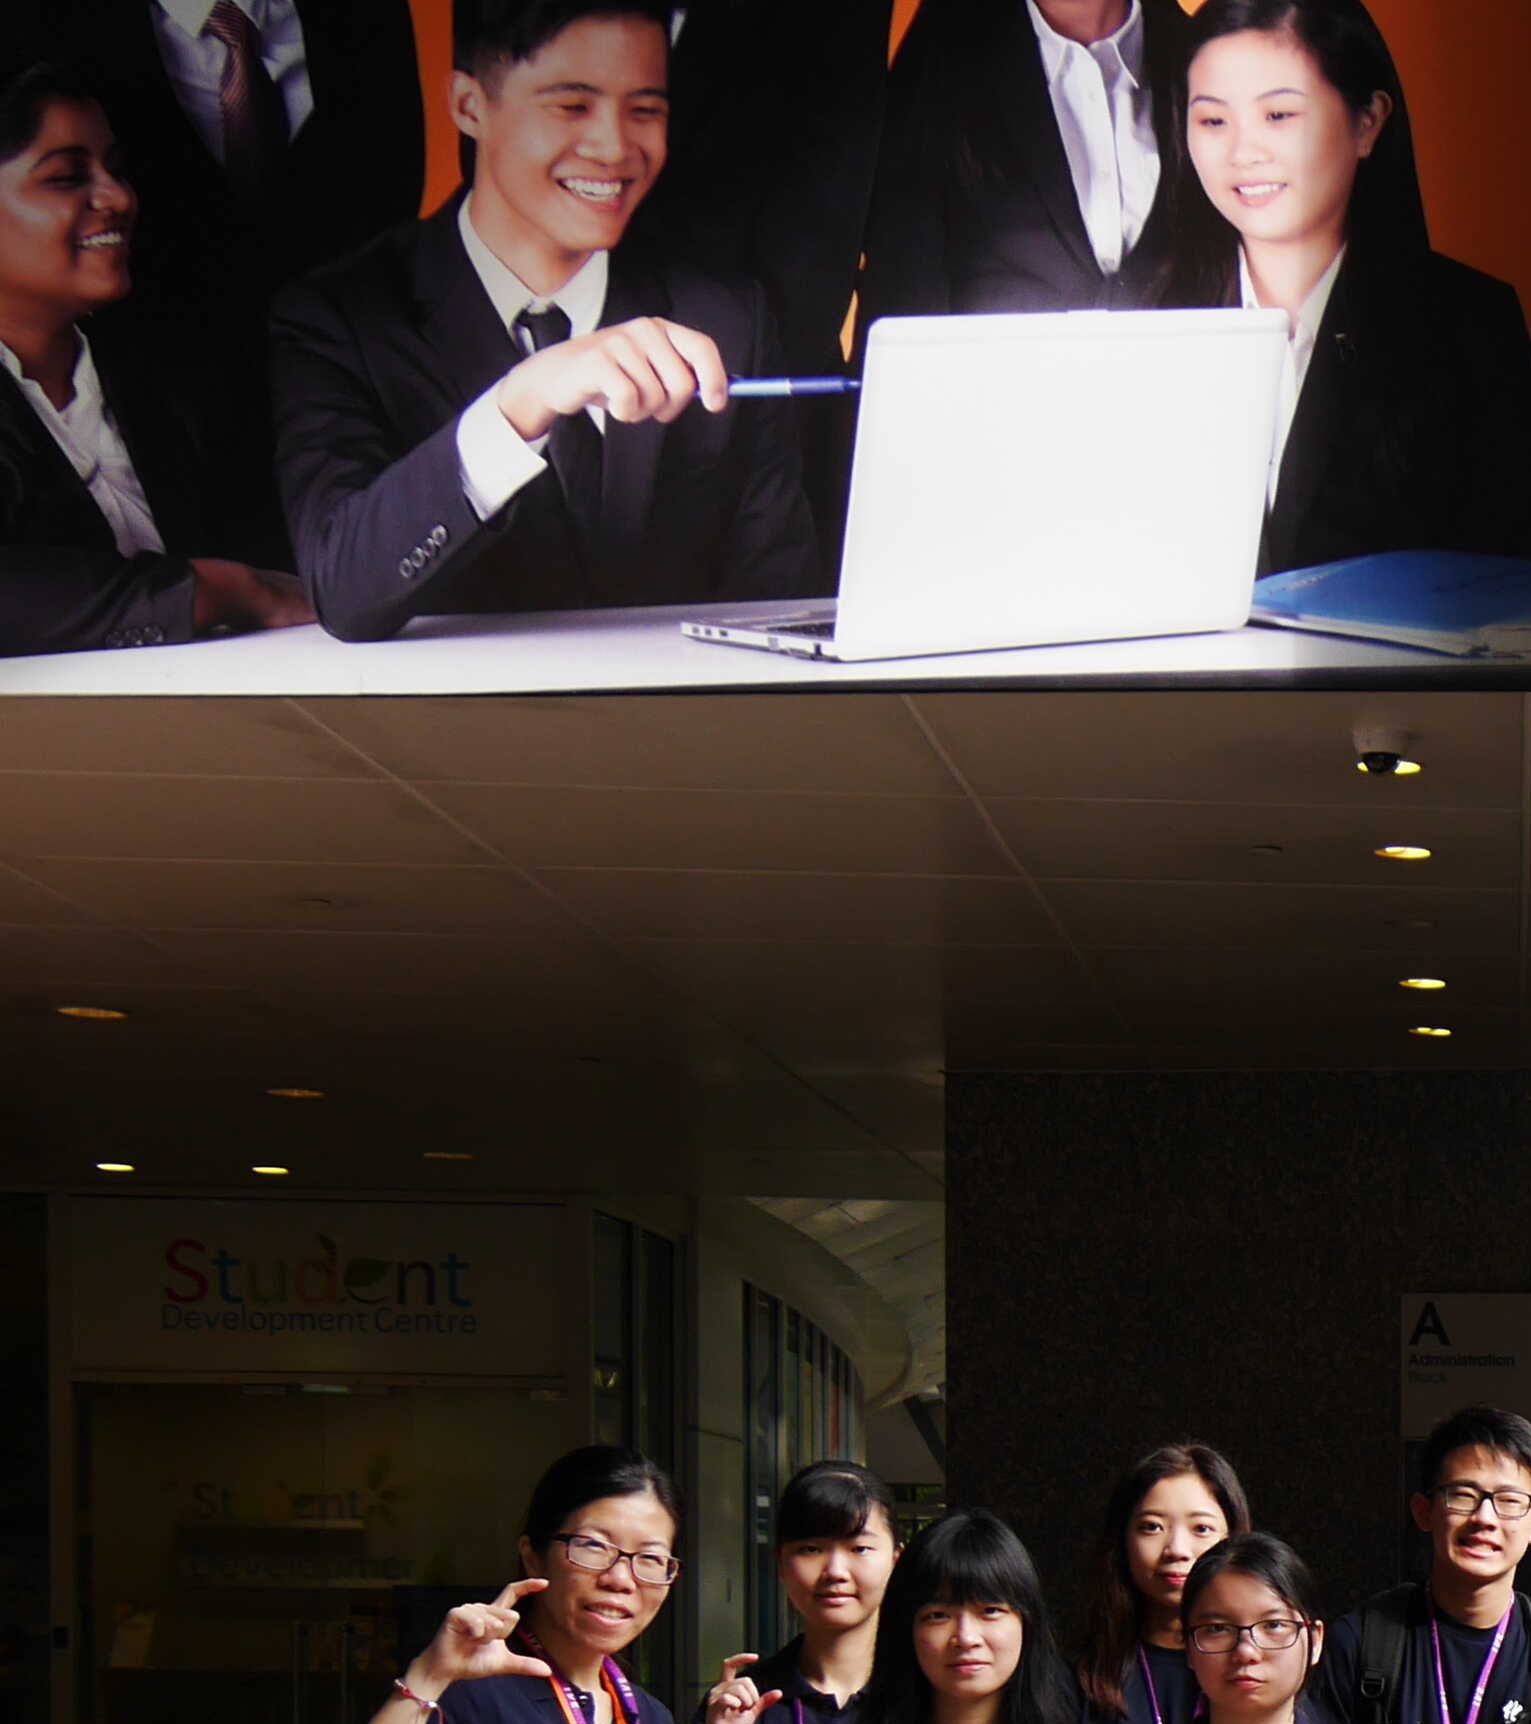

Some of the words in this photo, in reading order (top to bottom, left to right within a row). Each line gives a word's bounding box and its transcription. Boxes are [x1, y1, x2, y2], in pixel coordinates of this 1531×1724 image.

[165, 1233, 472, 1306] Student
[160, 1303, 368, 1336] Development
[375, 1306, 480, 1334] Centre
[1409, 1302, 1450, 1345] A
